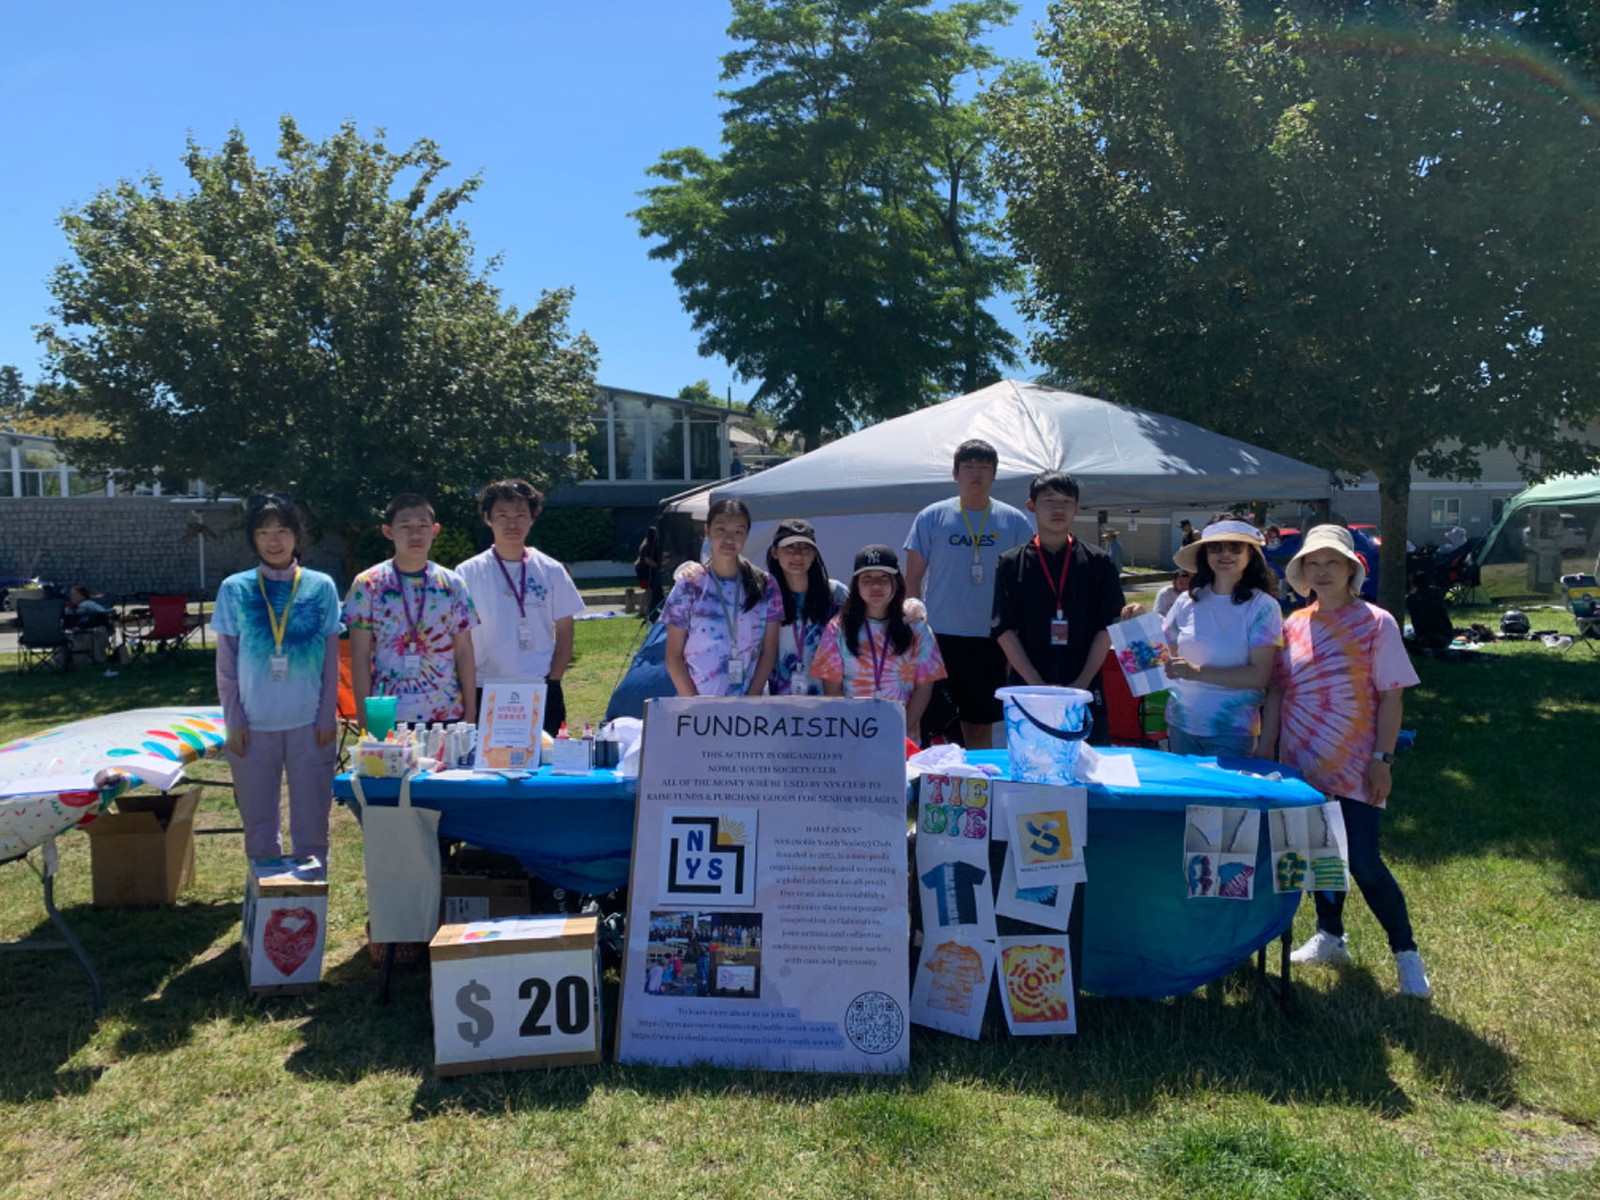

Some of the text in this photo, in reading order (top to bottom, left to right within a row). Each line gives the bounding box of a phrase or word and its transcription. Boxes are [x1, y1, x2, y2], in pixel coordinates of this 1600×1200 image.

[677, 714, 879, 739] FUNDRAISING
[702, 750, 723, 759] THIS
[725, 751, 765, 760] ACTIVITY
[708, 765, 737, 773] NOBLE
[739, 765, 772, 773] YOUTH
[773, 766, 810, 774] SOCIETY
[661, 778, 677, 787] ALL
[694, 779, 711, 788] THE
[713, 779, 745, 788] MONEY
[926, 774, 989, 808] TIE
[713, 793, 761, 802] PURCHASE
[922, 803, 988, 840] DYE
[687, 830, 704, 852] N
[455, 975, 590, 1048] $ 20
